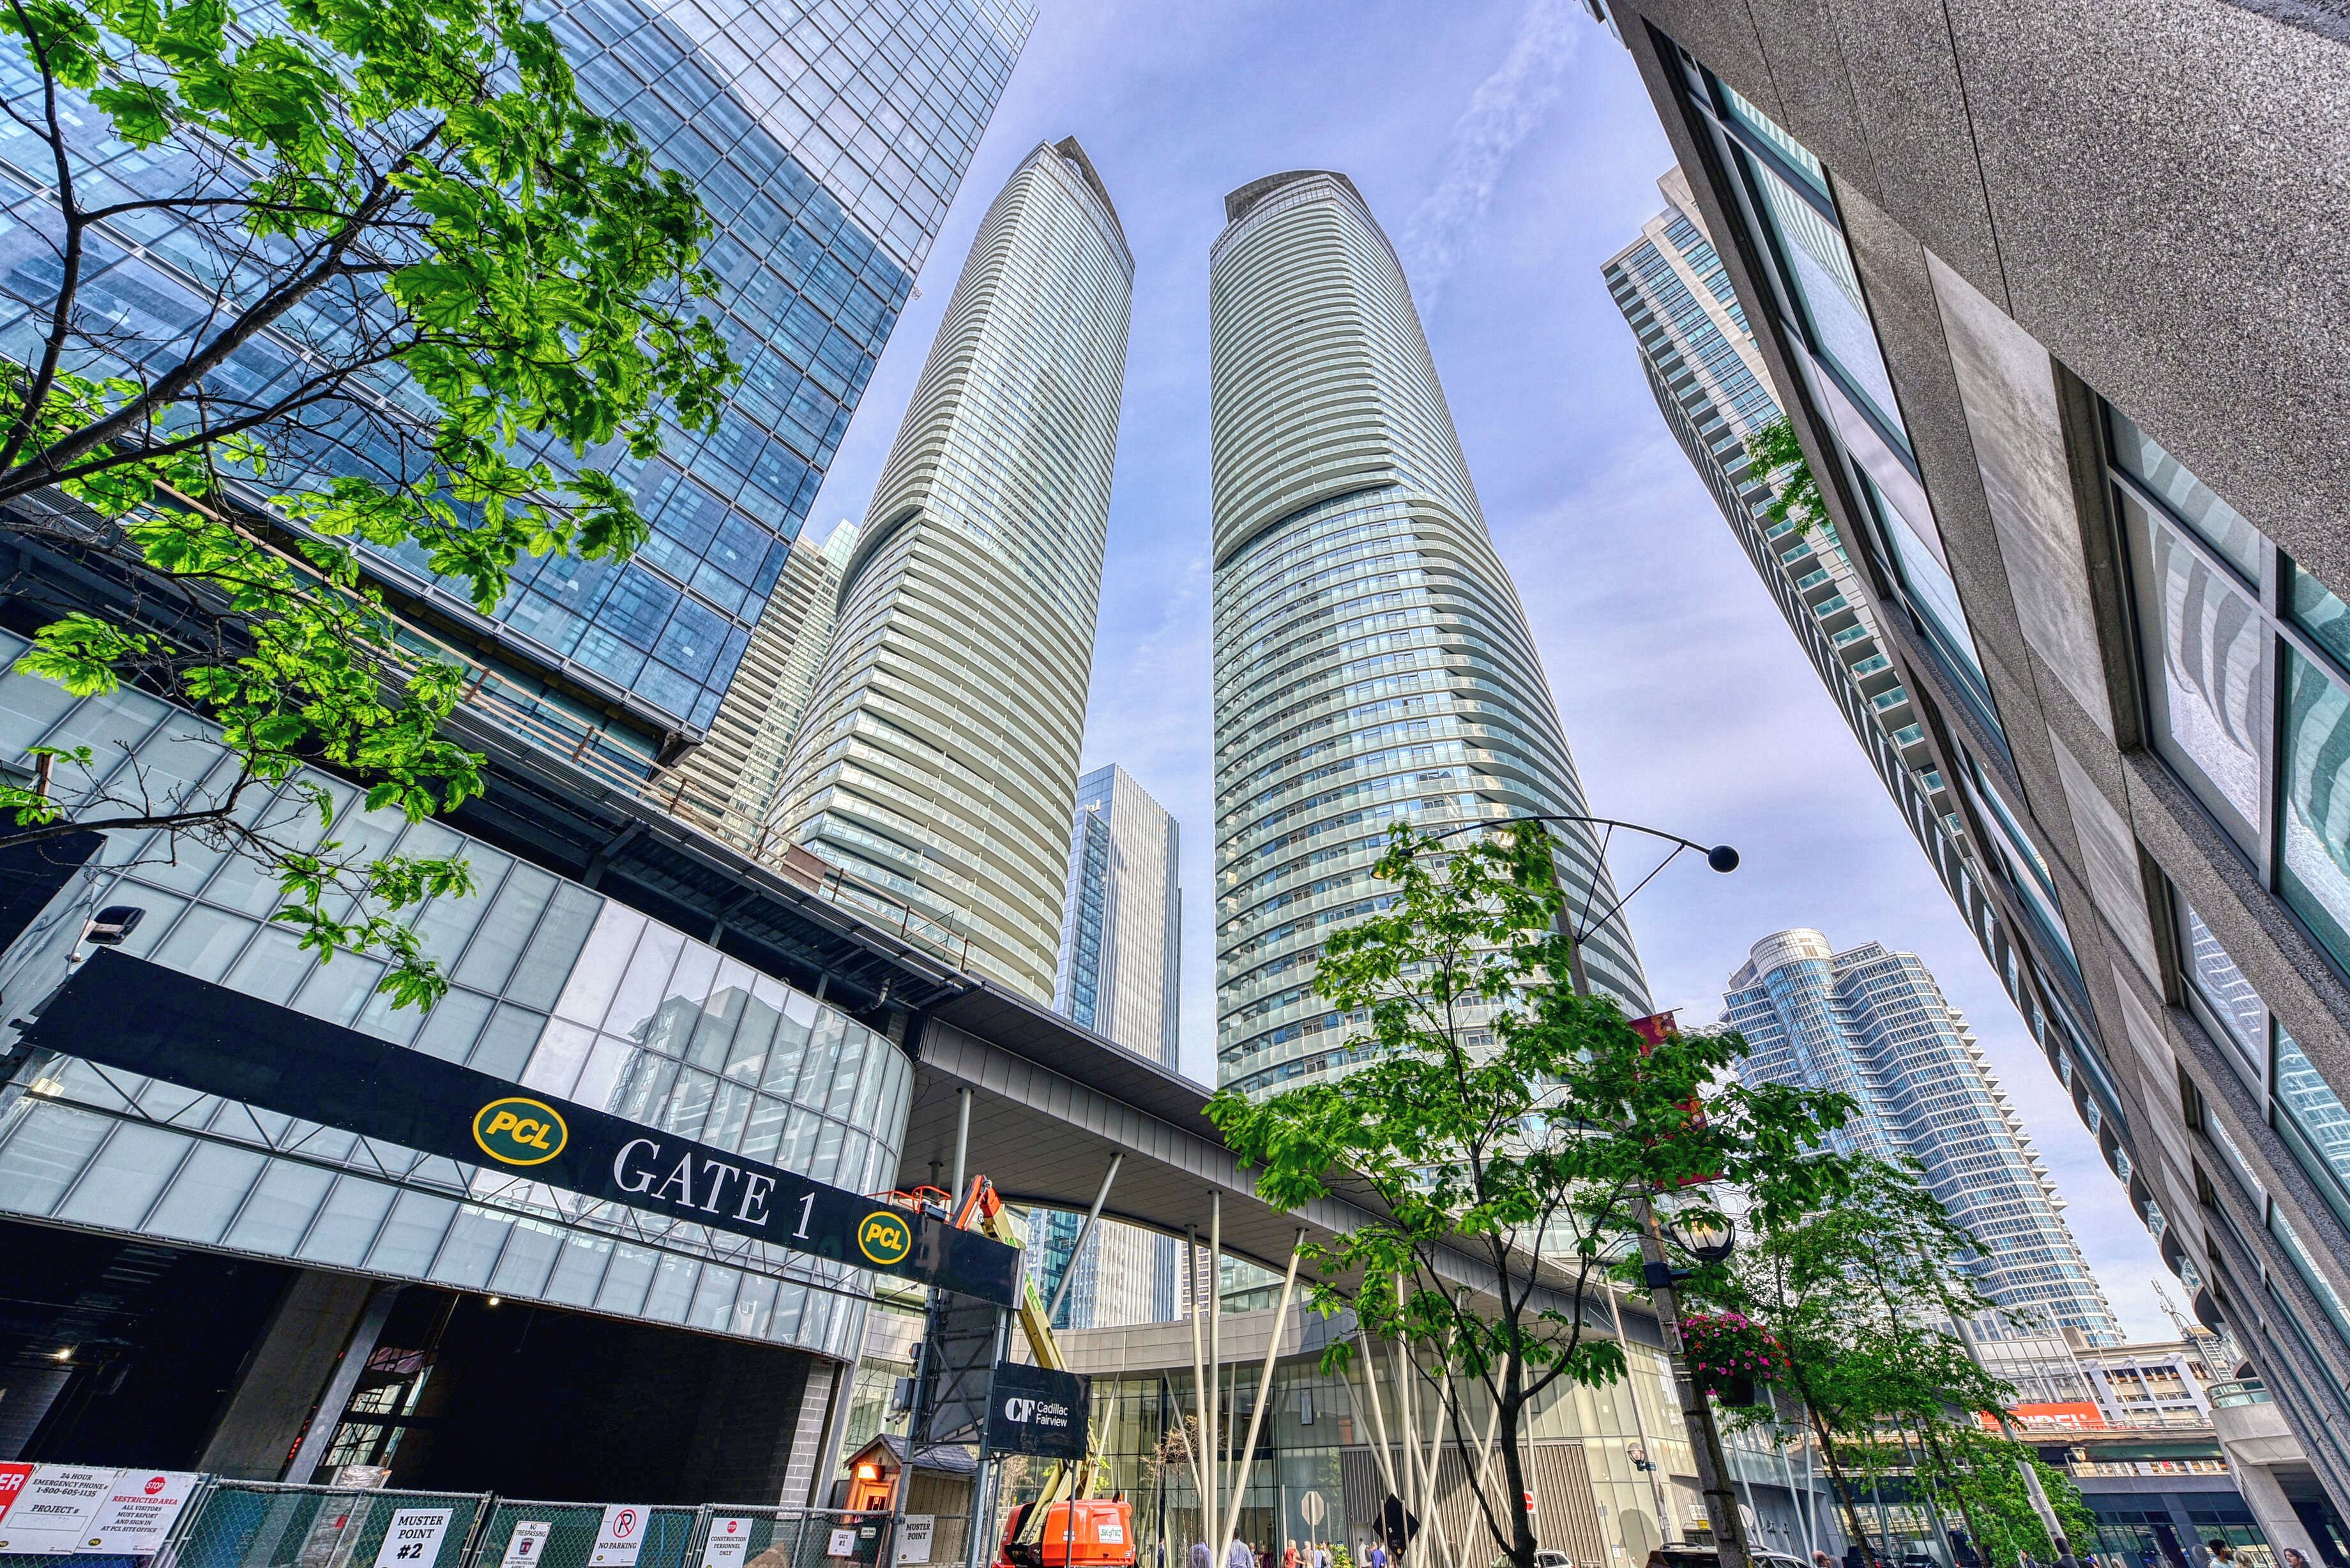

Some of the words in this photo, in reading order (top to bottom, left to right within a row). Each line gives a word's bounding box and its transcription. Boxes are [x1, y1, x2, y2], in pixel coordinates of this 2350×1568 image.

[485, 1110, 552, 1150] PCL
[613, 1138, 776, 1225] GATE
[792, 1193, 816, 1240] 1
[865, 1223, 903, 1251] PCL
[1005, 1398, 1035, 1422] CF
[1037, 1401, 1068, 1415] Cadillac
[1036, 1413, 1067, 1427] Fairview
[33, 1479, 78, 1488] EMERGENCY
[36, 1488, 96, 1497] 1-800-605-1135
[112, 1496, 158, 1504] RESTRICTED
[31, 1504, 73, 1514] PROJECT
[397, 1516, 444, 1526] MUSTER
[397, 1529, 434, 1539] POINT
[397, 1542, 423, 1559] #2
